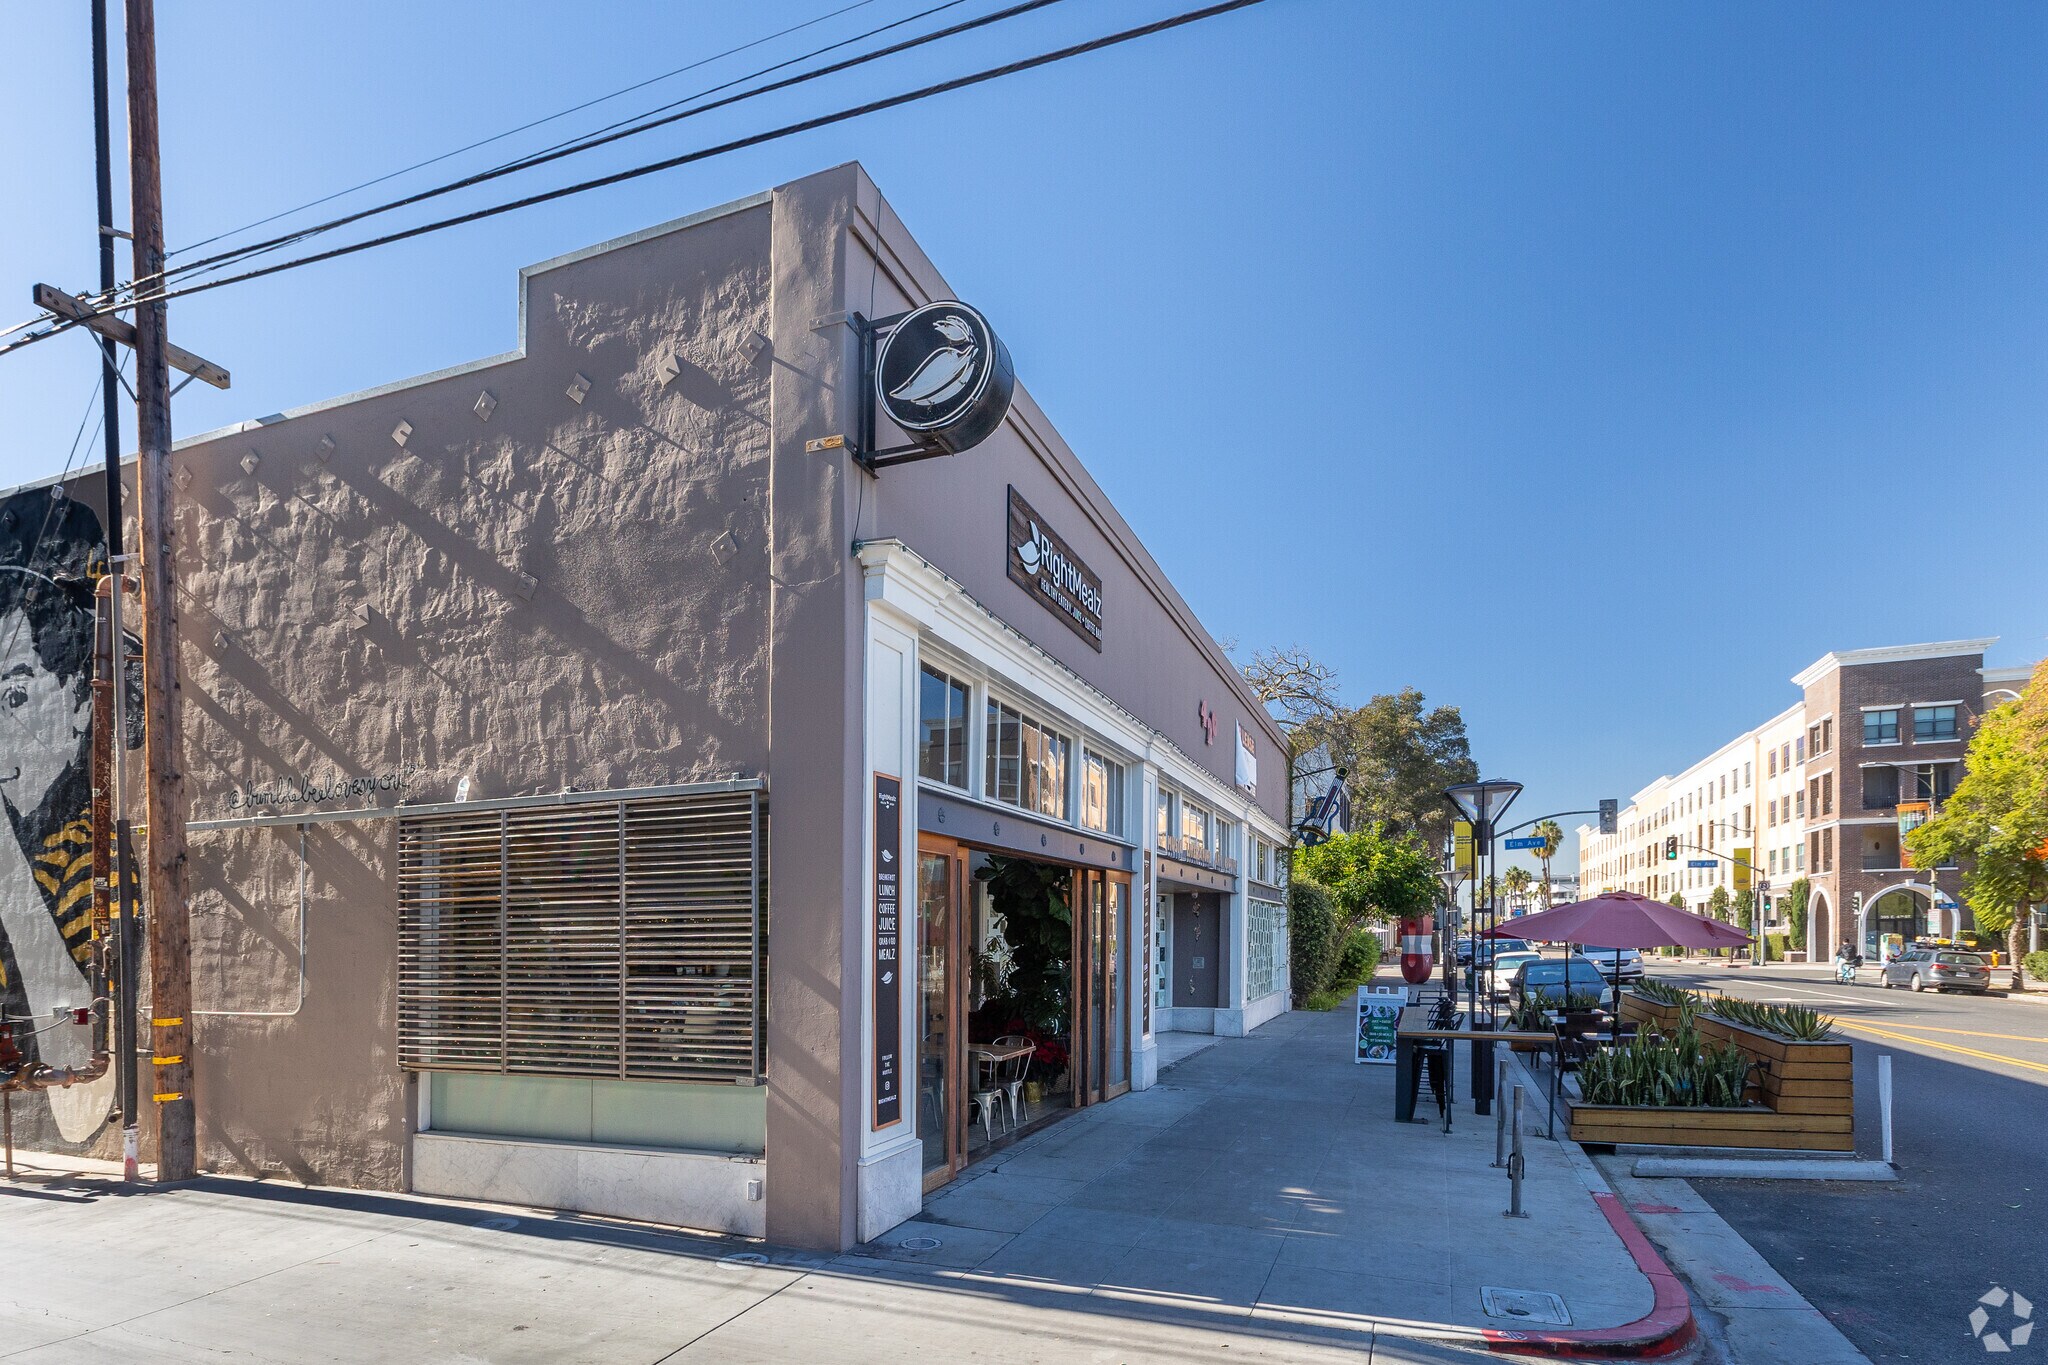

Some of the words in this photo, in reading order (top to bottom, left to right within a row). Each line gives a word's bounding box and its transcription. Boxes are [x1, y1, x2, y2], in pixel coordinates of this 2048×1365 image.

[1041, 534, 1101, 619] RightMealz
[1040, 578, 1058, 602] HEALTHY
[878, 884, 896, 896] LUNCH
[878, 904, 896, 914] COFFEE
[878, 917, 896, 930] JUICE
[878, 948, 896, 960] MEALZ
